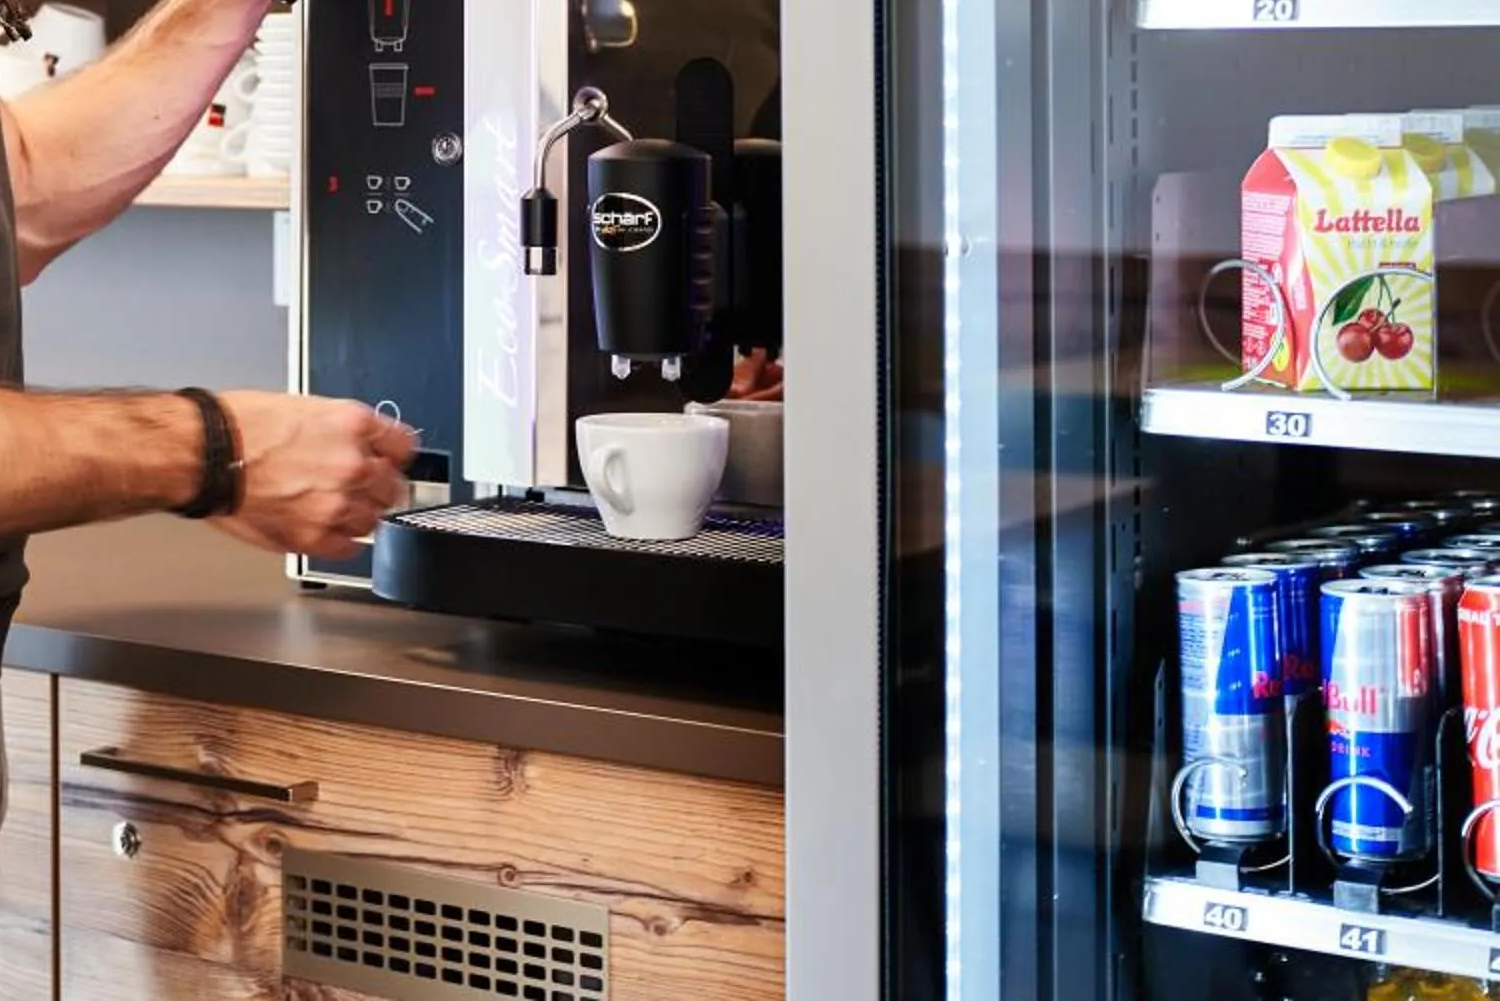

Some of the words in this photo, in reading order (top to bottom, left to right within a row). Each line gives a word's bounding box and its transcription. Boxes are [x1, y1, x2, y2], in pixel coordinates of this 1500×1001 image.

[1257, 0, 1293, 20] 20
[1313, 207, 1421, 234] Lattella
[1268, 413, 1306, 437] 30
[1327, 680, 1377, 715] Bull
[1204, 902, 1243, 931] 40
[1341, 925, 1378, 953] 41
